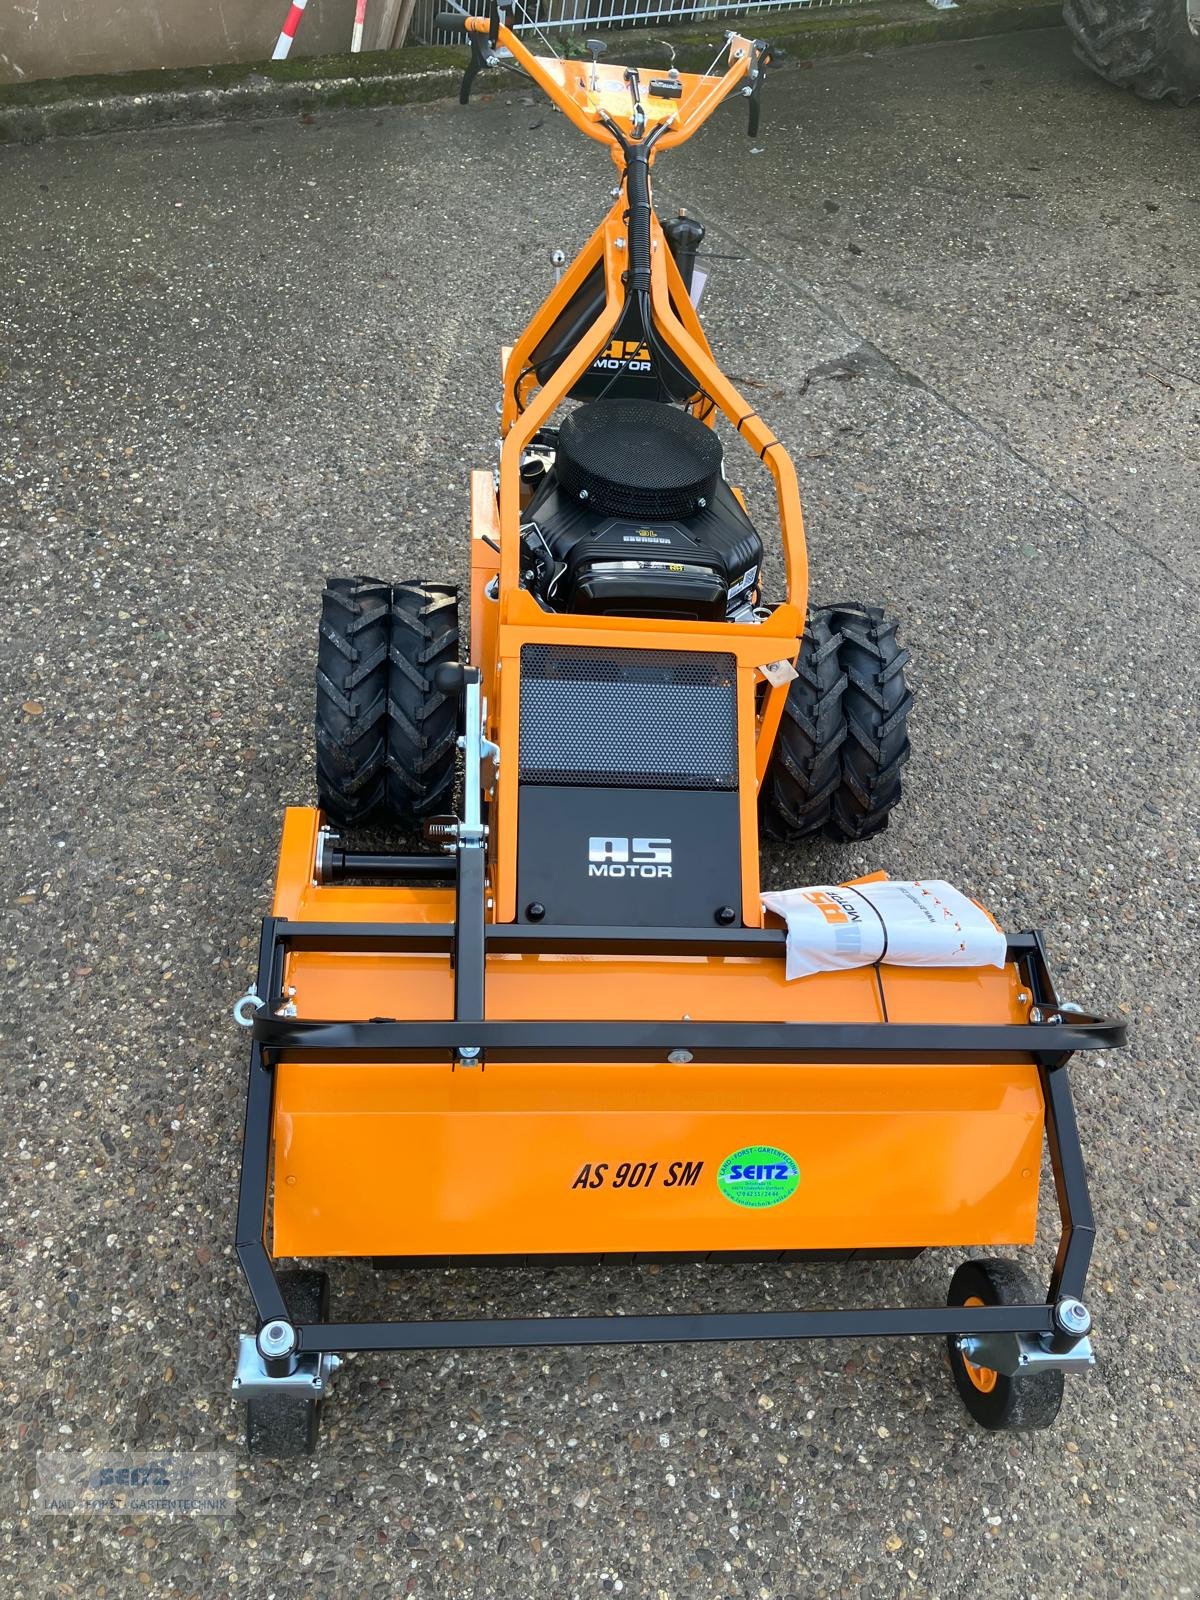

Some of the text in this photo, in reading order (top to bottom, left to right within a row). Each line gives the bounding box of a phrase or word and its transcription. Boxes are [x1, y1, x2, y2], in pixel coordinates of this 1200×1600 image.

[588, 837, 672, 863] AS
[588, 864, 673, 878] MOTOR
[571, 1161, 704, 1189] AS 901 SM
[720, 1159, 732, 1176] LAND
[734, 1148, 753, 1160] FORST
[729, 1165, 789, 1180] SEITZ
